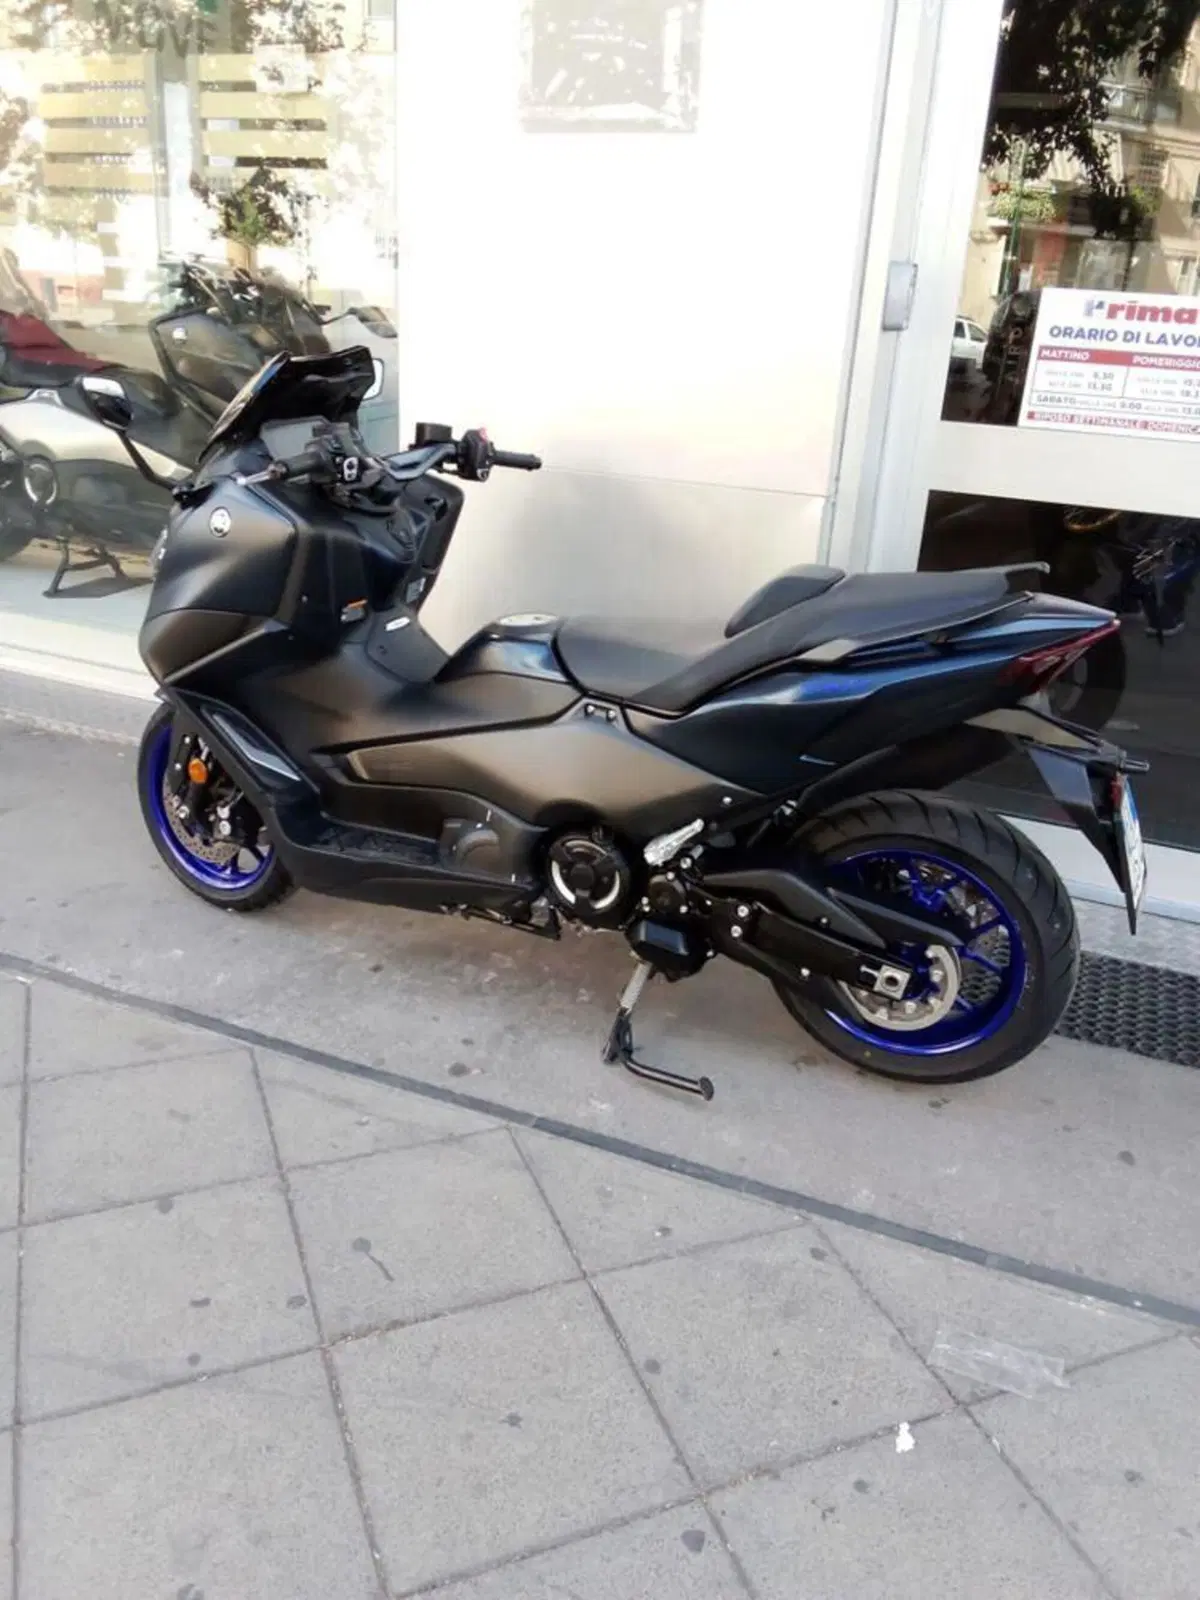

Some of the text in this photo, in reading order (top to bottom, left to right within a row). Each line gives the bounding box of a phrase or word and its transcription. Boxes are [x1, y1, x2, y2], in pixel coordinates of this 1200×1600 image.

[1049, 325, 1118, 342] ORARIO
[1122, 329, 1141, 344] DI
[1040, 348, 1090, 360] MATTINO
